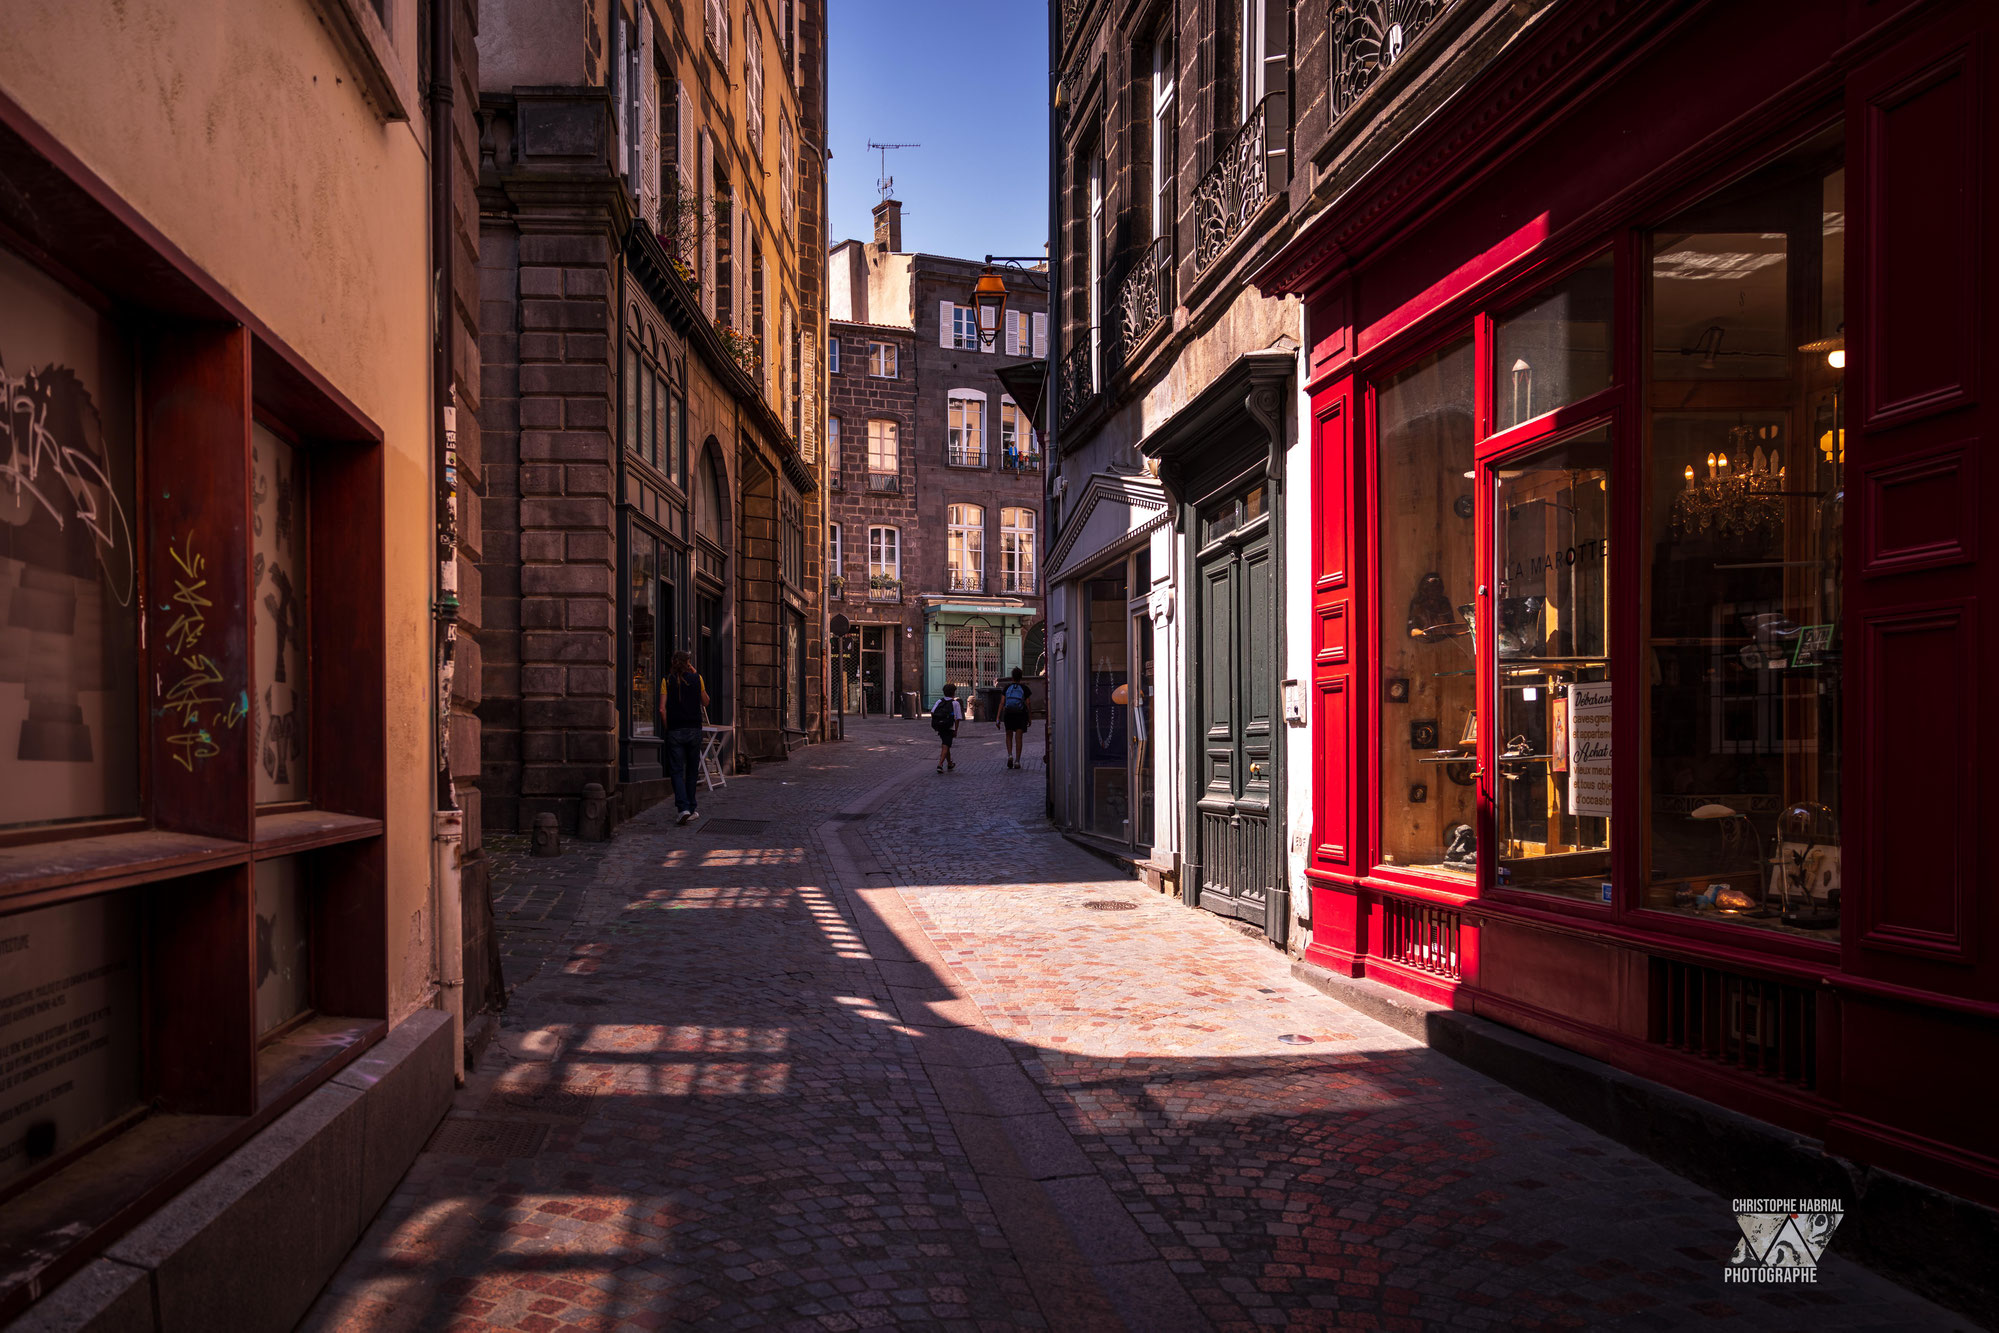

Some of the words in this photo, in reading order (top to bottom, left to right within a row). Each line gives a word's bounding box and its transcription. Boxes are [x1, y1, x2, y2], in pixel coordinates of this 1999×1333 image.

[1530, 538, 1608, 576] MAROTTE
[1573, 715, 1594, 724] caves
[1573, 729, 1579, 739] et
[1573, 742, 1608, 764] Achat
[1573, 764, 1591, 775] vieux
[1573, 780, 1580, 789] et
[1580, 780, 1595, 790] tous
